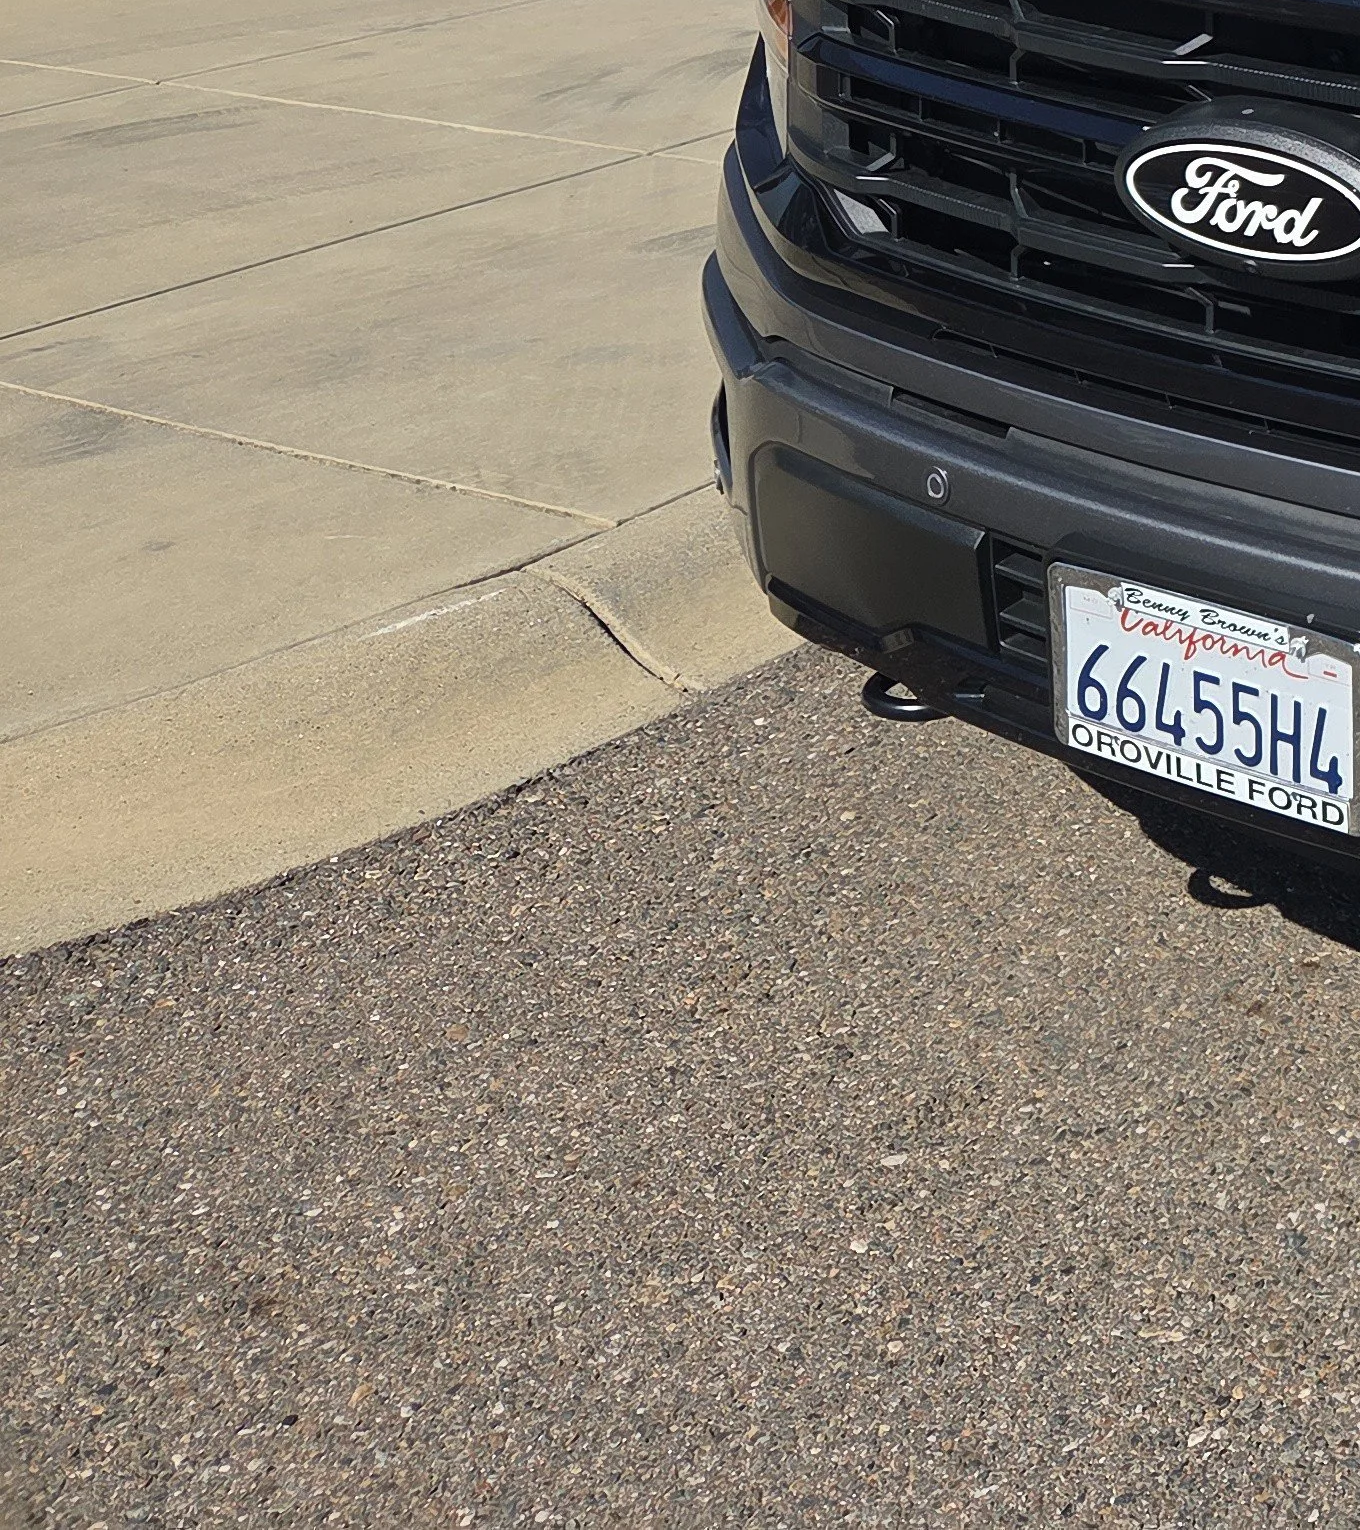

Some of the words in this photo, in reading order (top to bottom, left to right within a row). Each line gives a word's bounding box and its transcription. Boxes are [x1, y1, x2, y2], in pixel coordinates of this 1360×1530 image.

[1171, 156, 1324, 247] Ford
[1120, 607, 1309, 680] California
[1124, 587, 1191, 621] Benny
[1198, 608, 1288, 646] Brown's
[1077, 644, 1343, 795] 66455H4
[1071, 723, 1236, 795] OROVILLE
[1248, 778, 1345, 826] FORD
